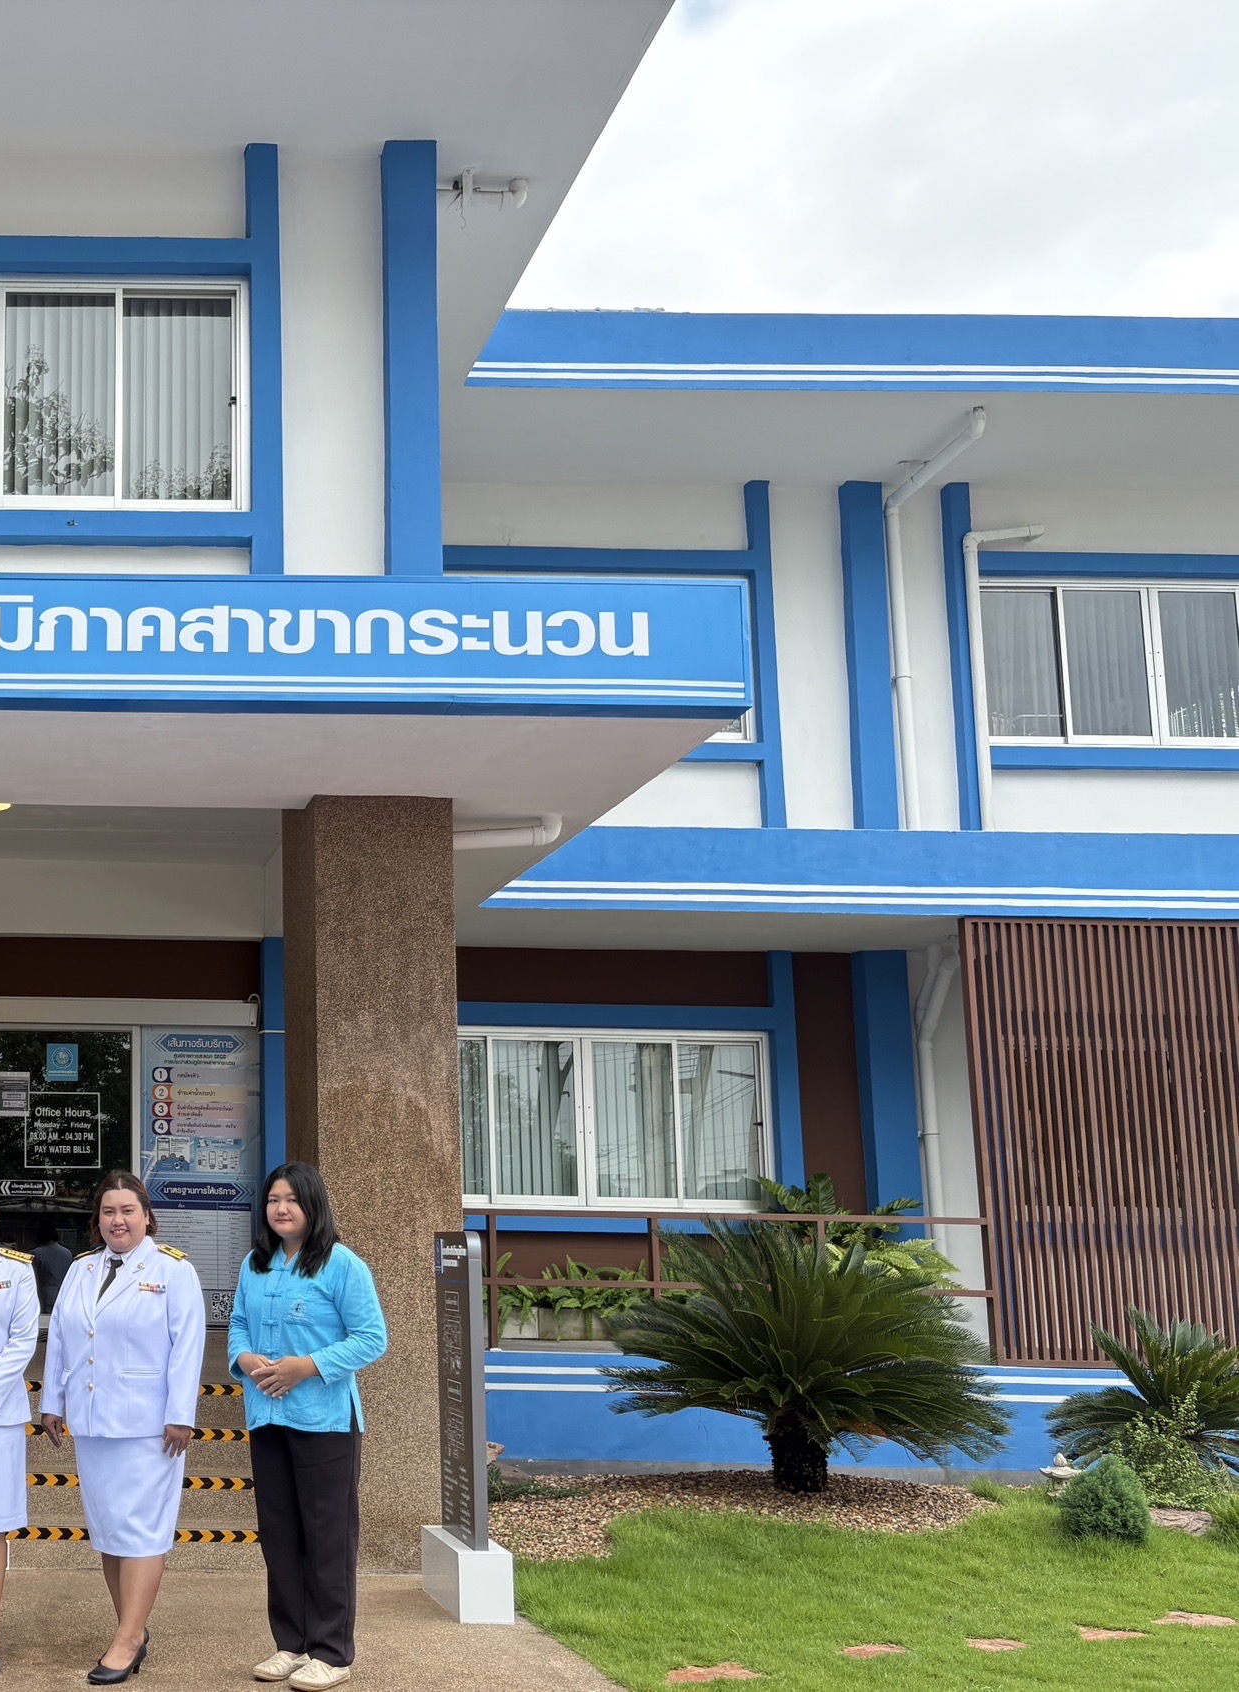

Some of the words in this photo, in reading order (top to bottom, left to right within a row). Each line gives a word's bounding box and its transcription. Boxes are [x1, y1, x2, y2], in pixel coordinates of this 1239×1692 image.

[167, 1037, 234, 1049] เส้นทางรับบริการ
[158, 1070, 163, 1079] 1
[158, 1089, 164, 1097] 2
[35, 1107, 61, 1117] Office
[64, 1107, 92, 1117] Hours
[158, 1105, 164, 1114] 3
[33, 1121, 61, 1130] Monday
[70, 1121, 92, 1130] Friday
[157, 1123, 164, 1131] 4
[29, 1132, 47, 1141] 08.00
[47, 1132, 61, 1141] AM.
[65, 1132, 82, 1141] 04.30
[83, 1132, 96, 1141] PM.
[34, 1145, 47, 1153] PAY
[48, 1145, 71, 1154] WATER
[73, 1145, 91, 1154] BILLS
[163, 1186, 237, 1196] มาตรฐานการให้บริการ
